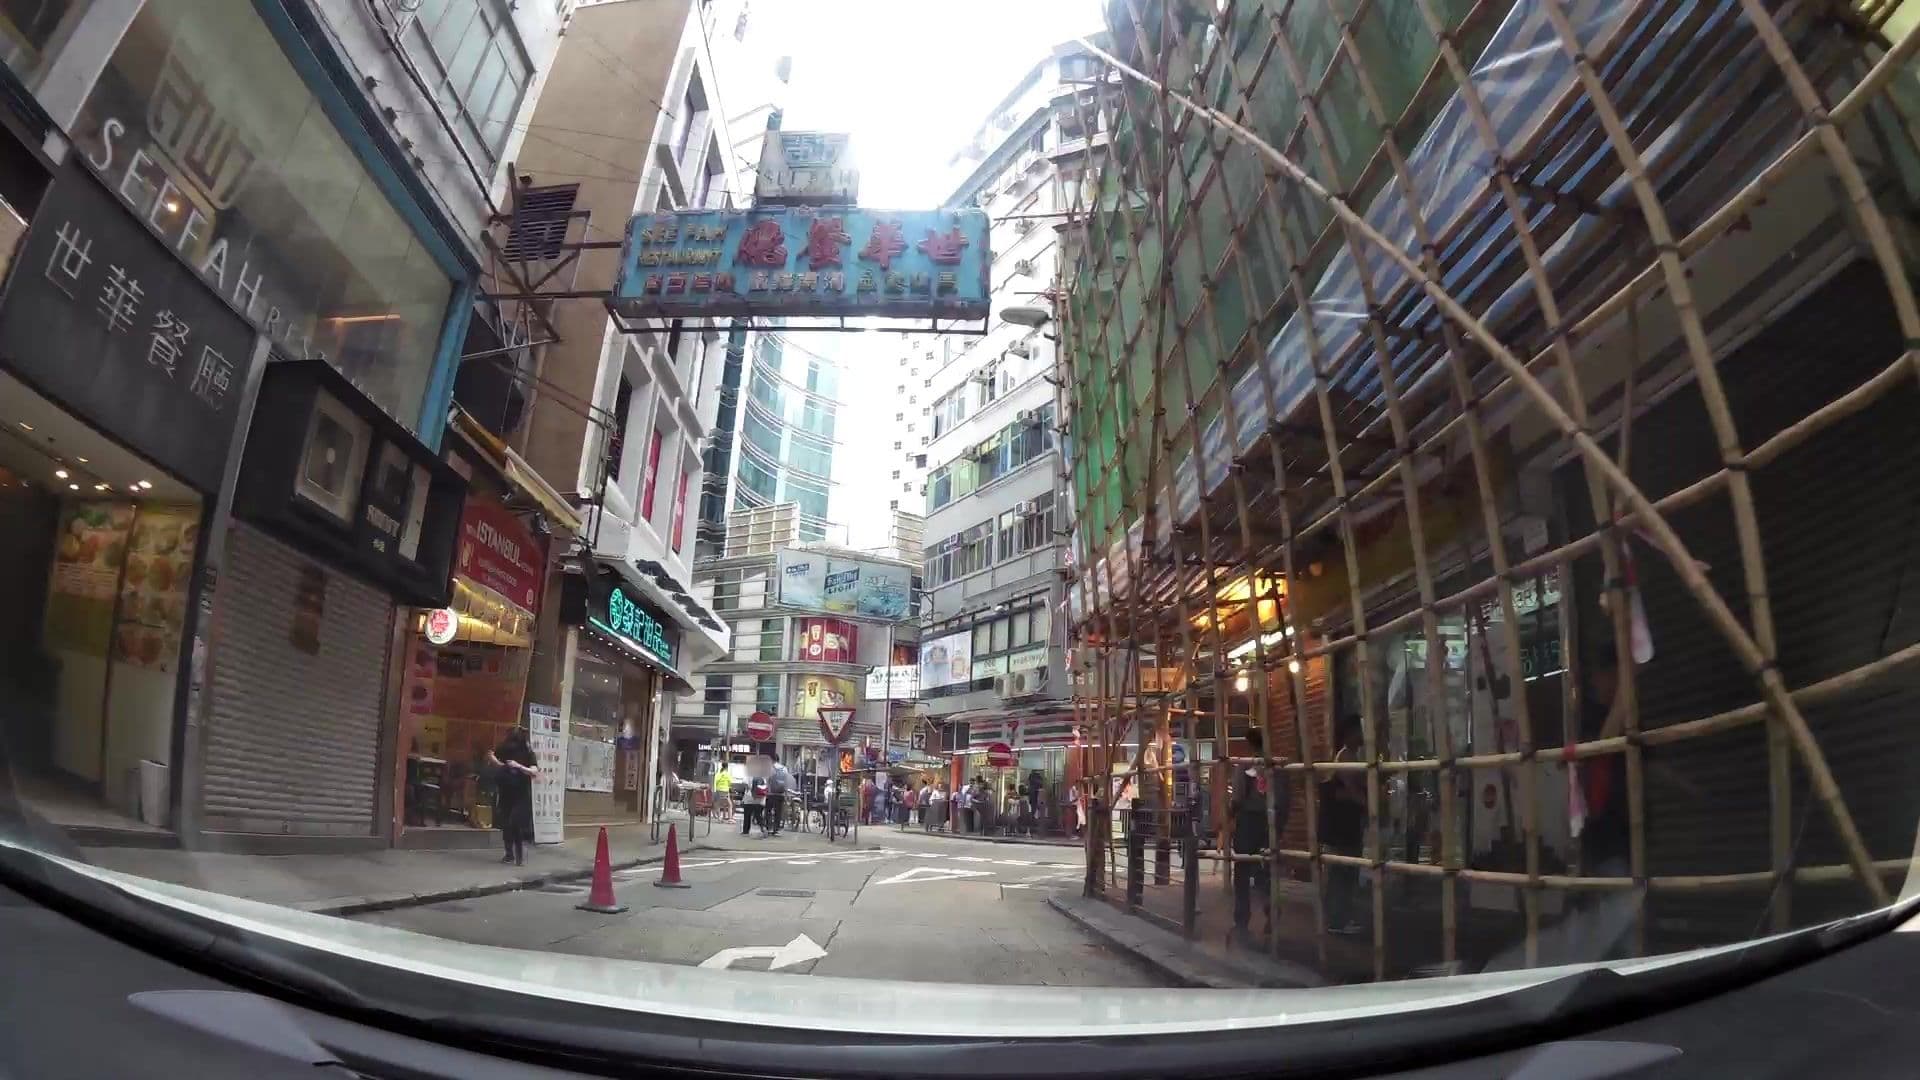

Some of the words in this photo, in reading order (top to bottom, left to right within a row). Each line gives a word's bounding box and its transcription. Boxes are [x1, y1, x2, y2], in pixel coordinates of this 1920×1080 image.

[43, 220, 236, 413] 世華餐廳
[476, 519, 521, 568] ISTANBUL
